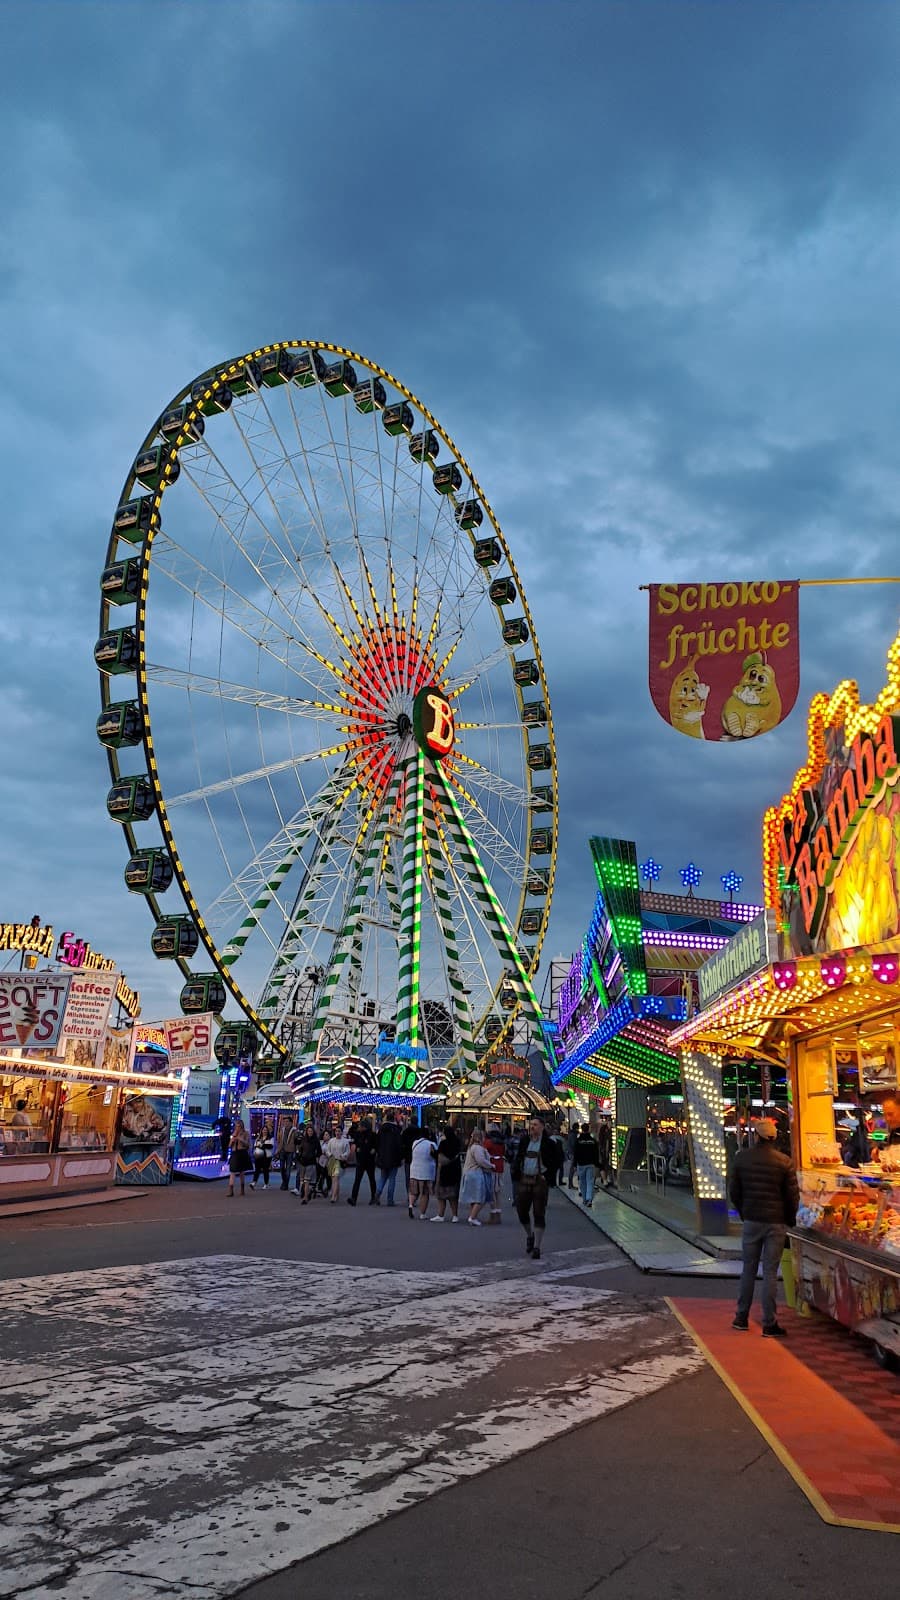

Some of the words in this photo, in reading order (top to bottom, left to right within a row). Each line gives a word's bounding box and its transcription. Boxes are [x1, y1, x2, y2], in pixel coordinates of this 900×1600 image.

[657, 581, 793, 616] Schoko-
[659, 617, 790, 670] früchte
[796, 715, 897, 935] Bamba
[701, 926, 761, 1001] Schokofrüchte
[0, 986, 65, 1008] SOFT
[63, 1024, 85, 1034] Coffee
[85, 1027, 94, 1035] to
[95, 1029, 103, 1037] go
